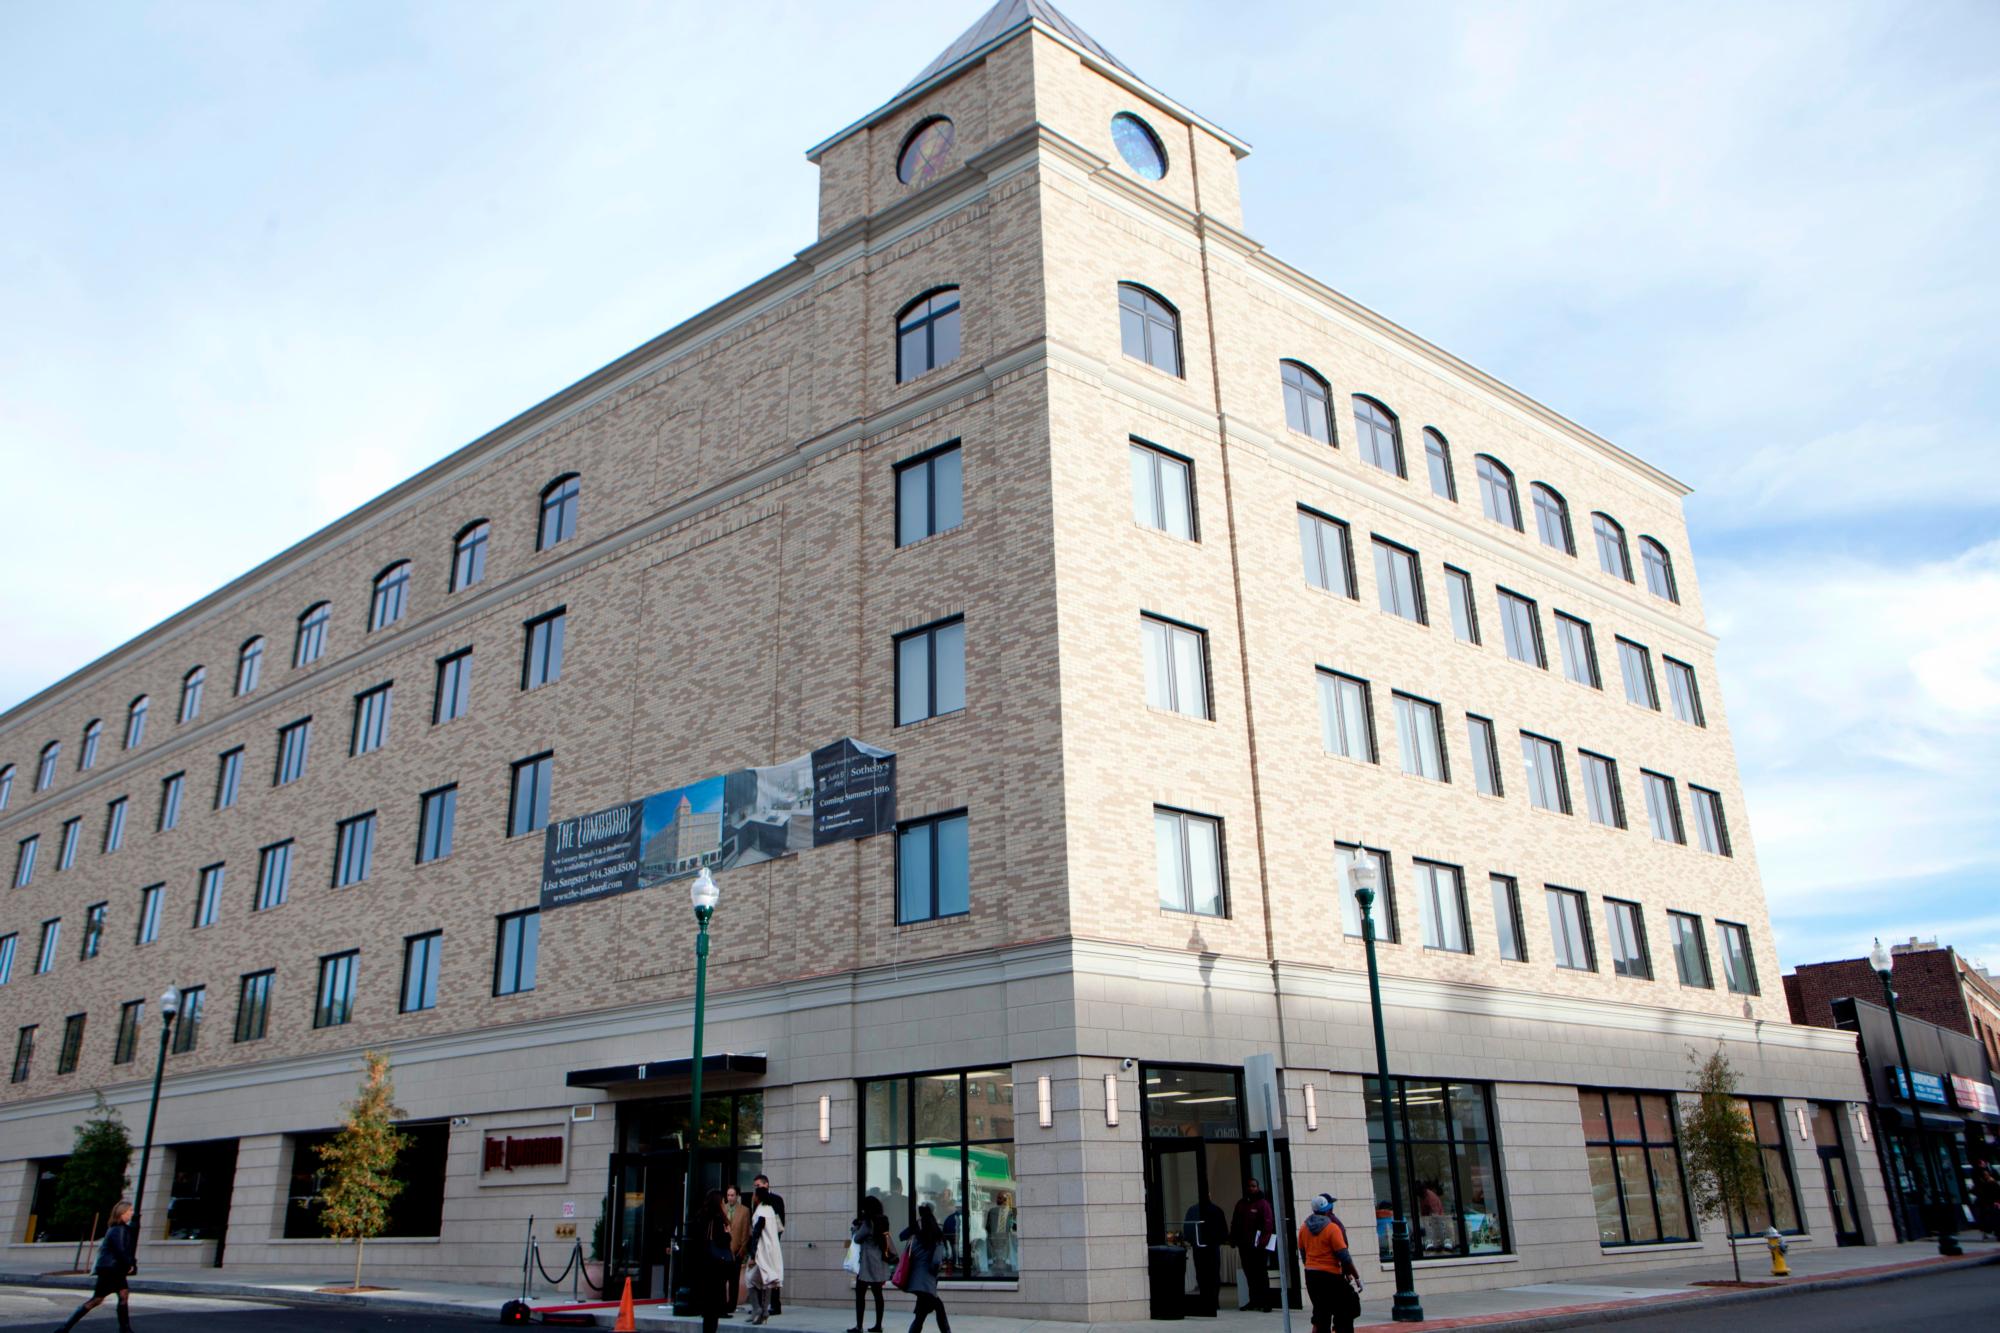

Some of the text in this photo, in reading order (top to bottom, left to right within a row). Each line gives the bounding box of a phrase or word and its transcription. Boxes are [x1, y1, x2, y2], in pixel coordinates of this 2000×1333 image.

[850, 763, 890, 776] Sotheby's
[820, 785, 890, 807] Coming Summer 2016
[556, 806, 631, 853] THE LOMBARDI
[543, 880, 558, 891] Lisa
[559, 874, 588, 889] Sangster
[638, 1065, 646, 1080] 11
